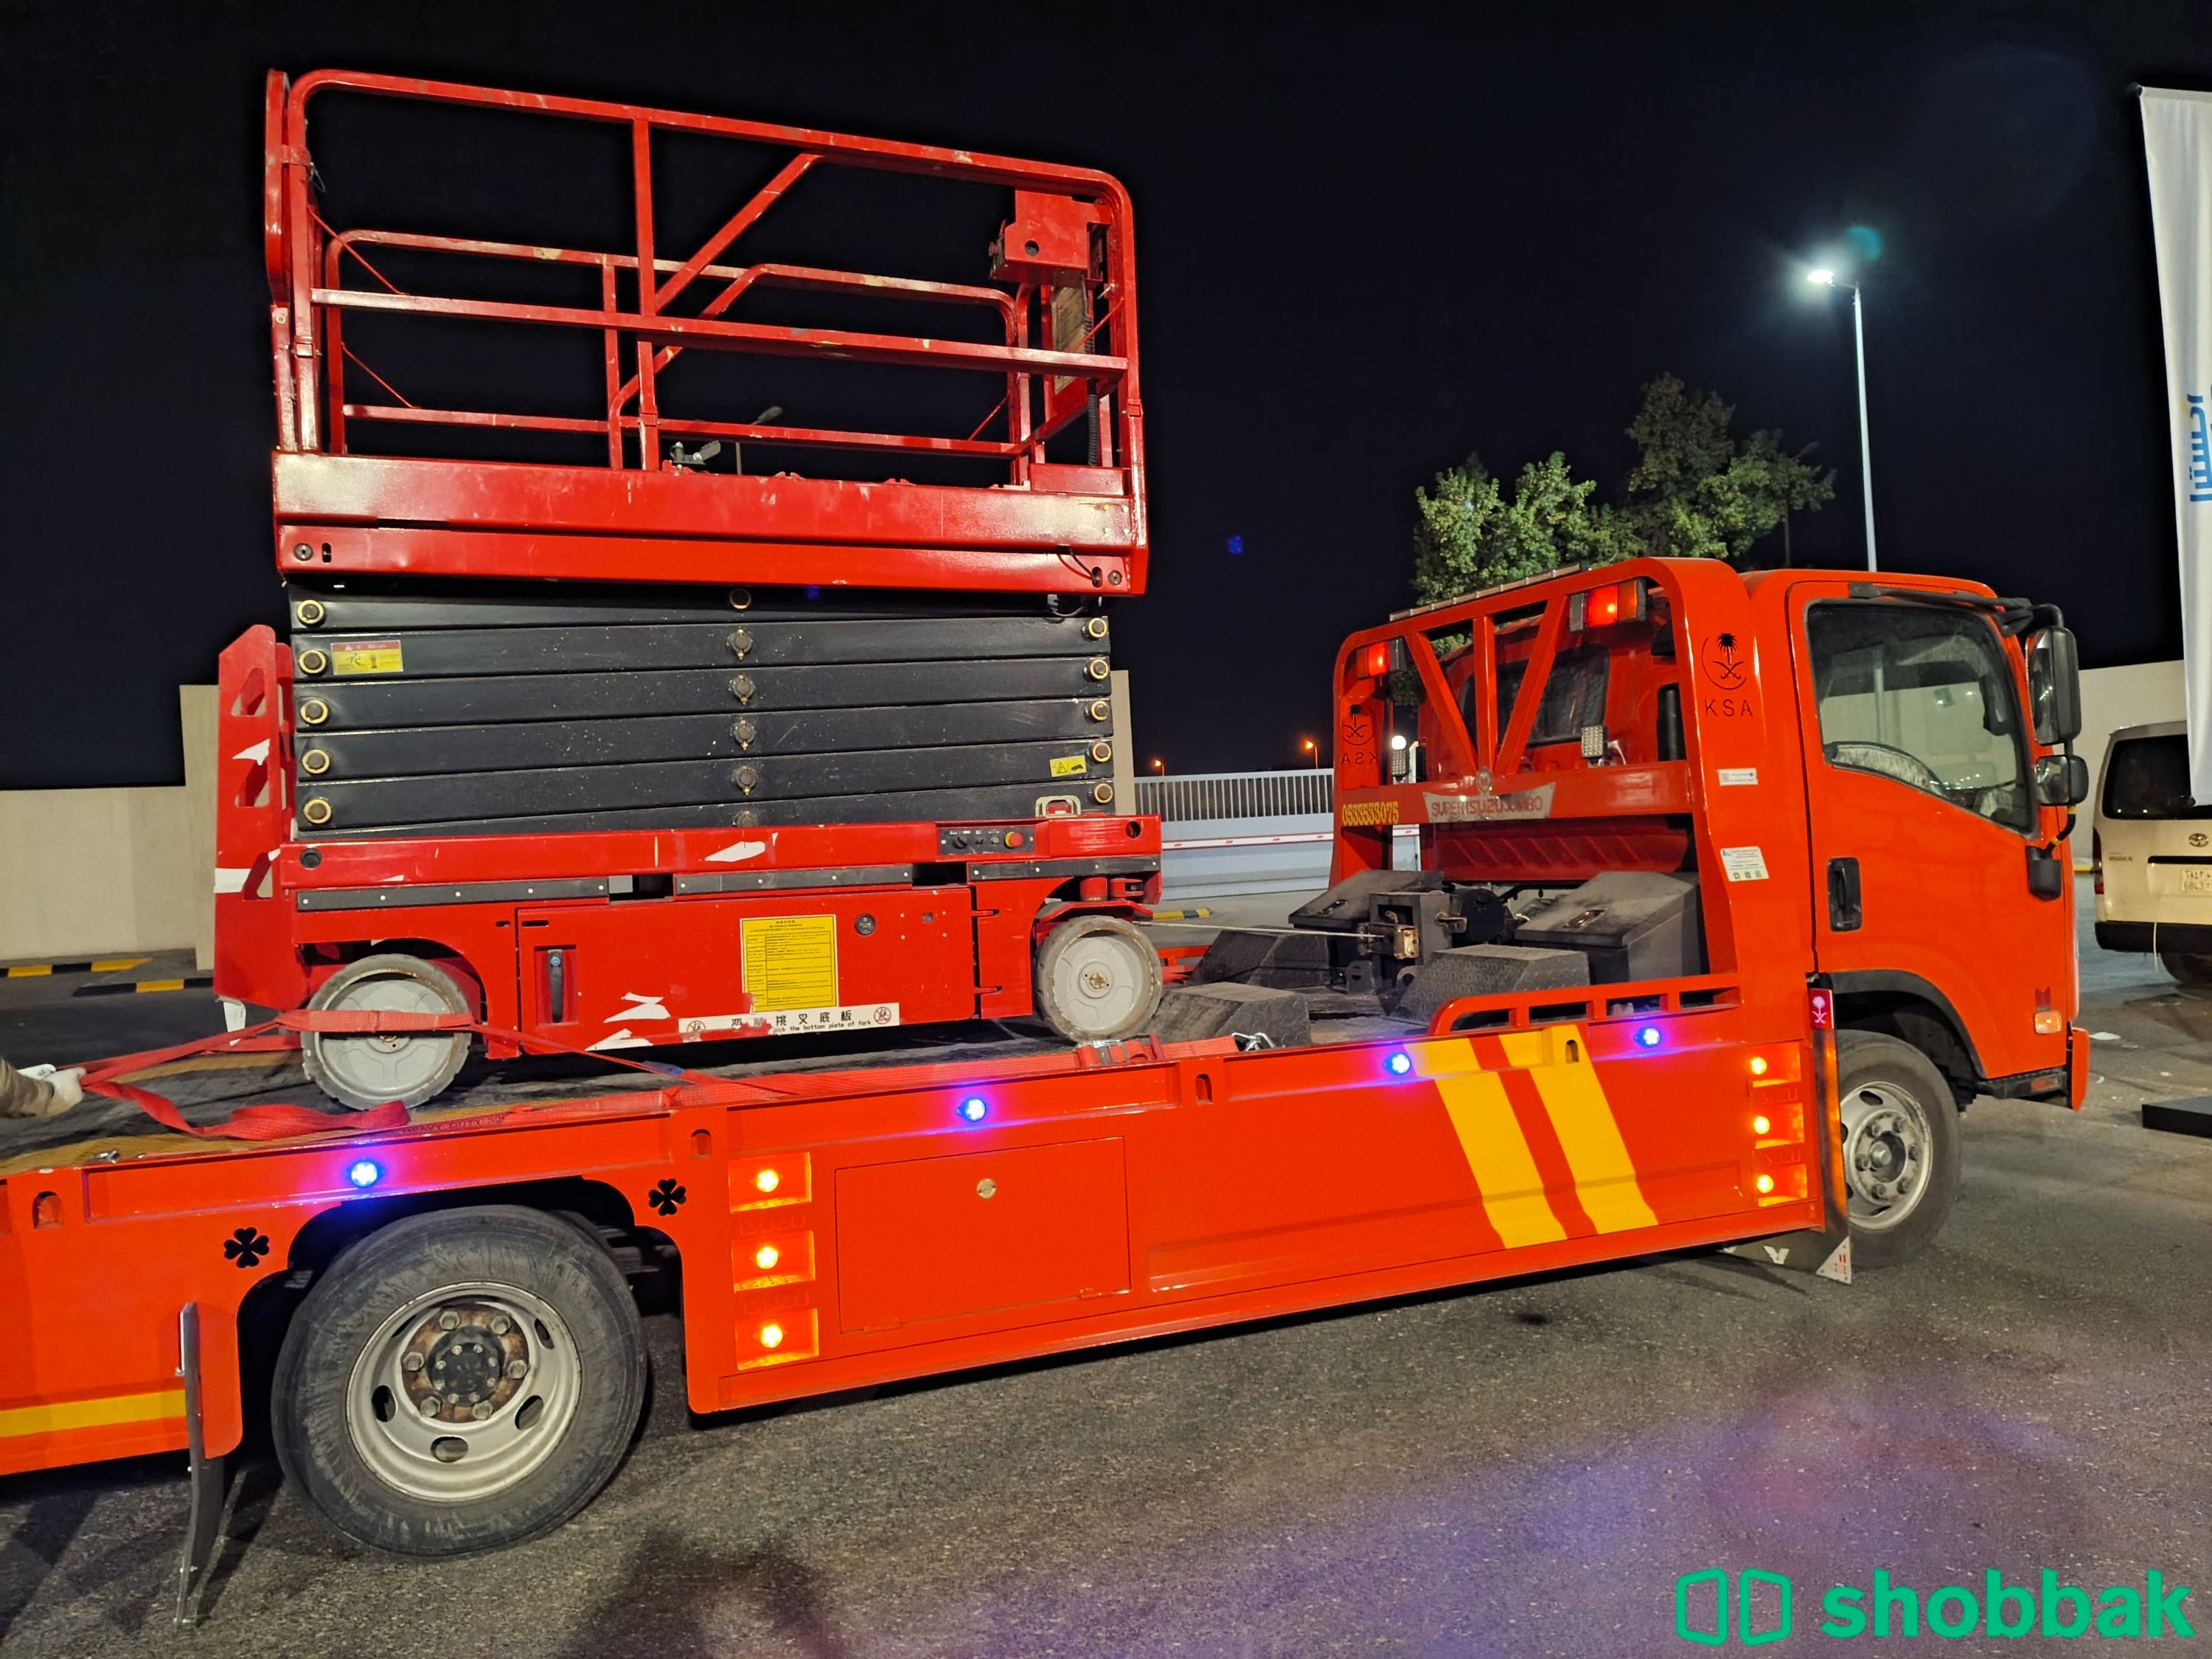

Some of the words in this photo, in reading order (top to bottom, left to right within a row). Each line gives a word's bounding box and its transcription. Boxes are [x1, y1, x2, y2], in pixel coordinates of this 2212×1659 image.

[1704, 698, 1753, 717] KSA
[1431, 801, 1464, 816] SUPER
[1465, 799, 1503, 815] ISUZU
